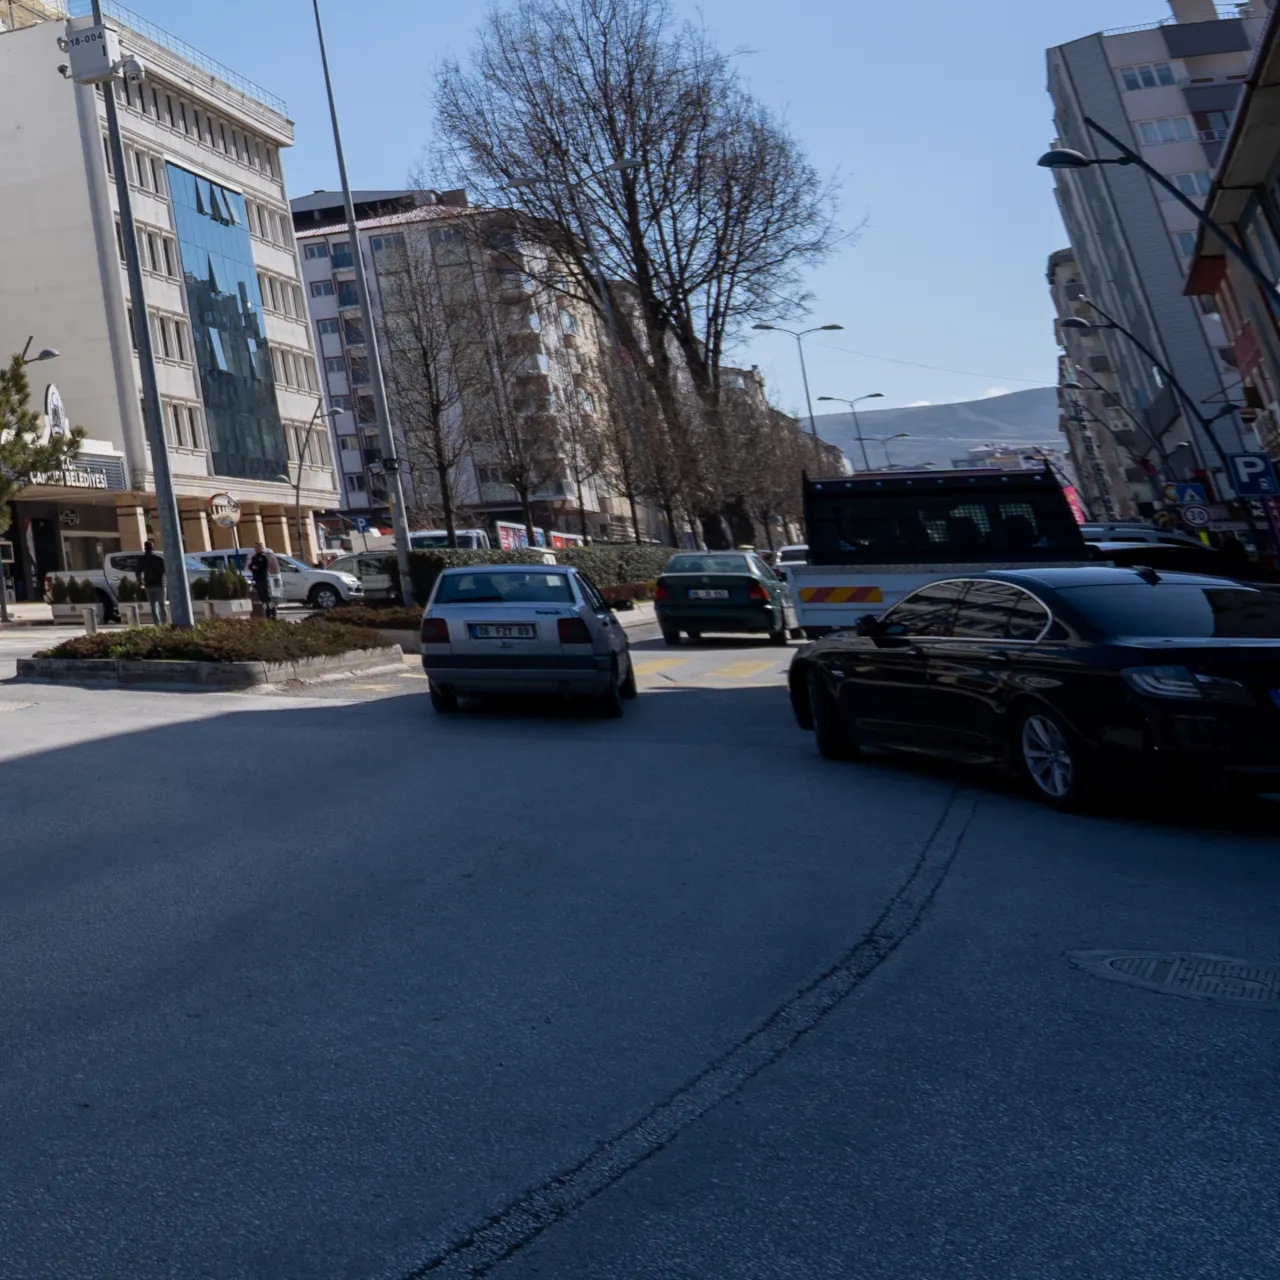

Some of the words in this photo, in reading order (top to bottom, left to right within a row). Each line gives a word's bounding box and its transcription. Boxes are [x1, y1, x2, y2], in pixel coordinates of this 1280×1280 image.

[70, 31, 103, 47] 18-004
[65, 467, 108, 489] BELEDİYESİ
[1233, 456, 1266, 483] P
[358, 518, 366, 531] P
